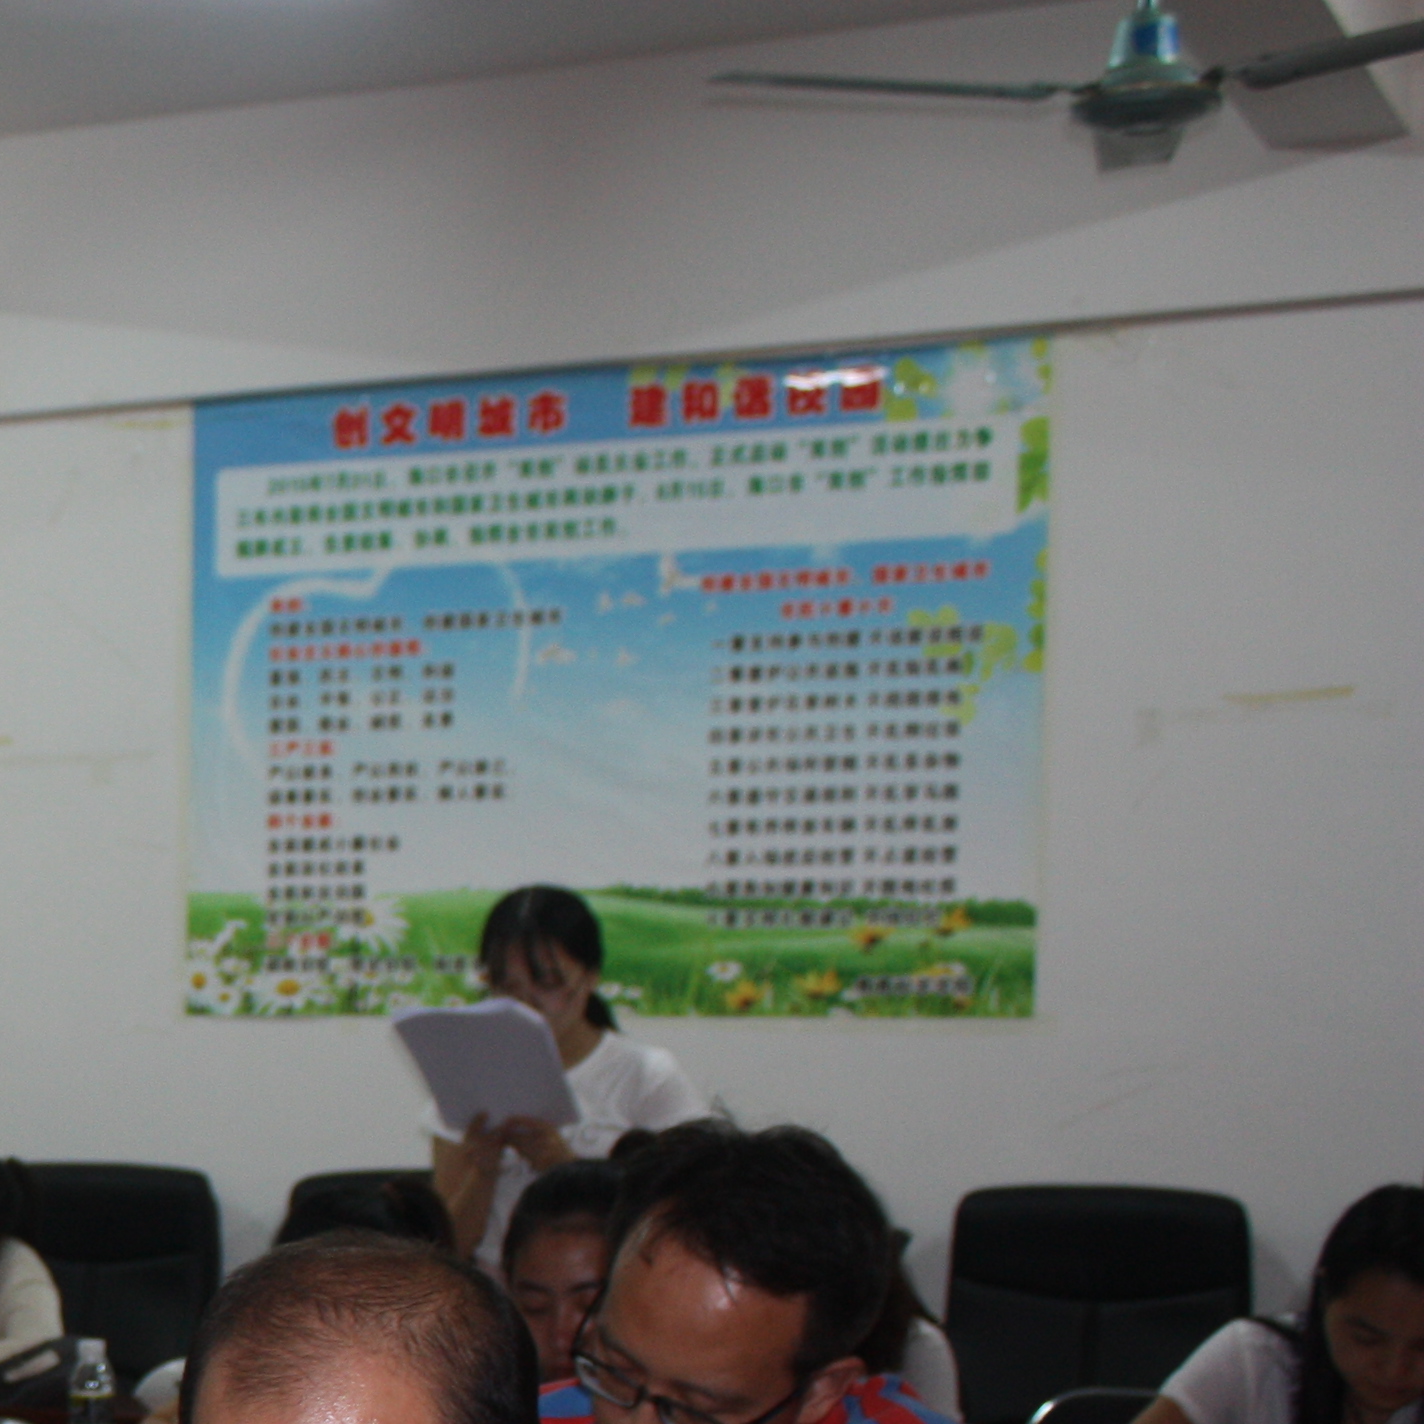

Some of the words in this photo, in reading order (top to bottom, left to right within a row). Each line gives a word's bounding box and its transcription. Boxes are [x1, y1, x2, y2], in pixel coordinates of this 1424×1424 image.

[333, 389, 568, 448] 创文明城市
